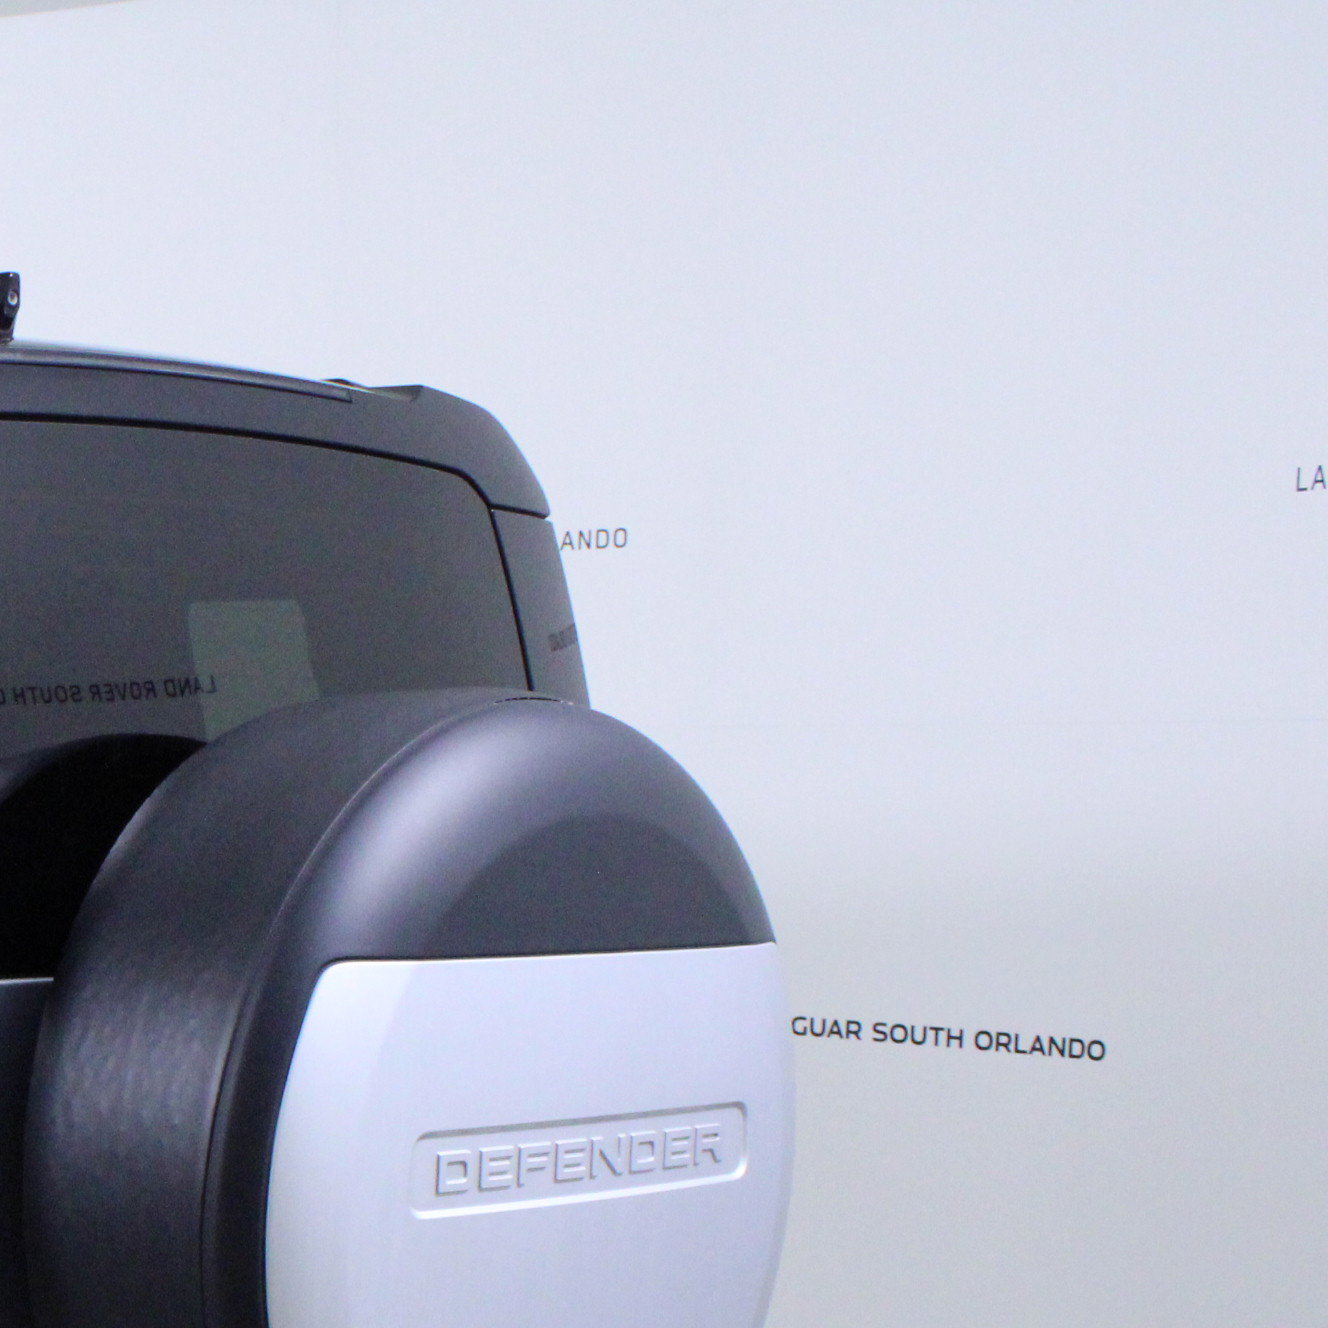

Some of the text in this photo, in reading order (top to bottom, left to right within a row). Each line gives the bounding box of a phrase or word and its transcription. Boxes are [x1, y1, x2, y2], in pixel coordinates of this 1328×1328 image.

[791, 1015, 1107, 1062] GUAR SOUTH ORLANDO
[435, 1122, 723, 1197] DEFENDER
